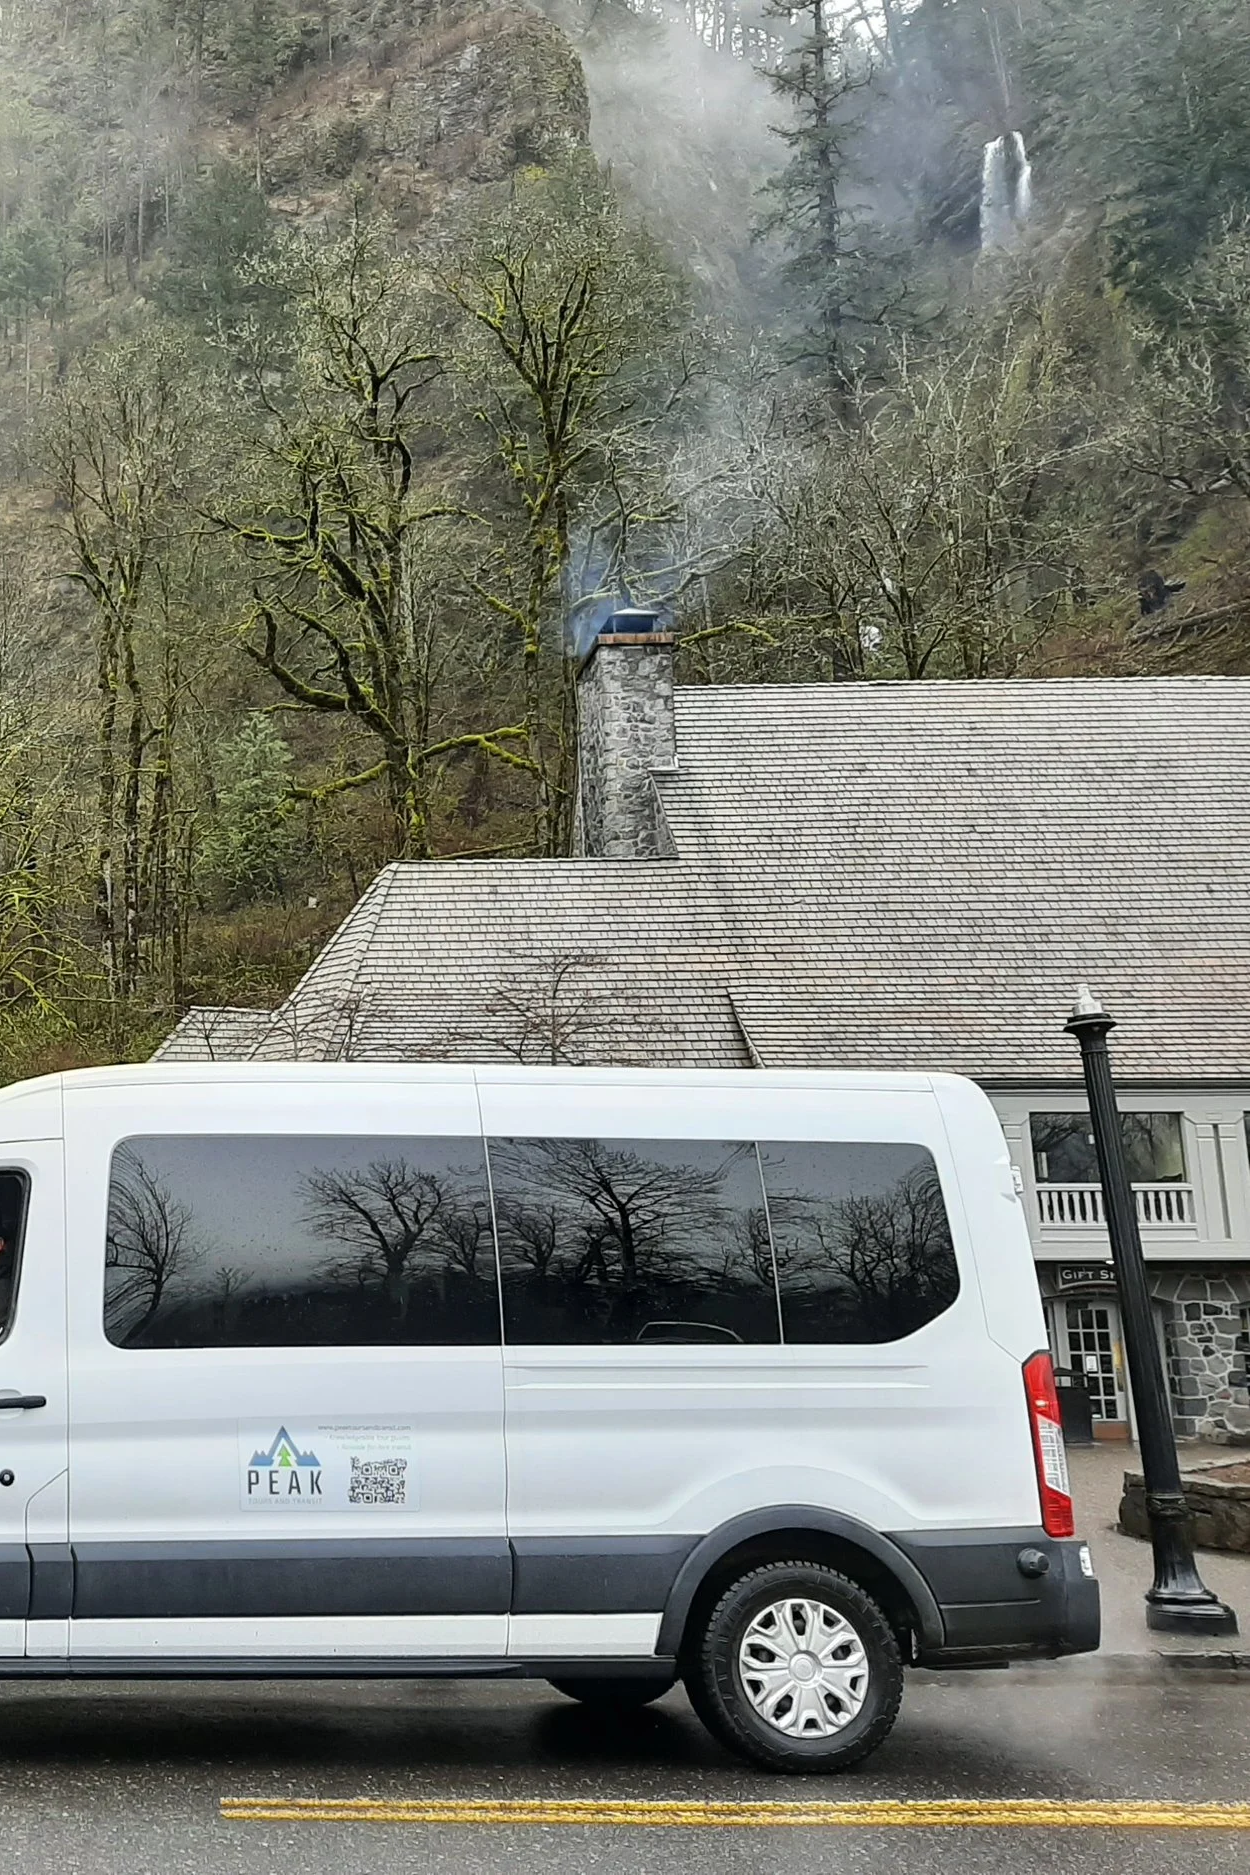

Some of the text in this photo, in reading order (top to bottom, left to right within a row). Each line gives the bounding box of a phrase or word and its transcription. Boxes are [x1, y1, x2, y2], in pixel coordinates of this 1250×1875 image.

[1062, 1269, 1094, 1280] GIFT
[247, 1469, 323, 1495] PEAK
[274, 1497, 291, 1505] AND
[291, 1497, 323, 1505] TRANSIT
